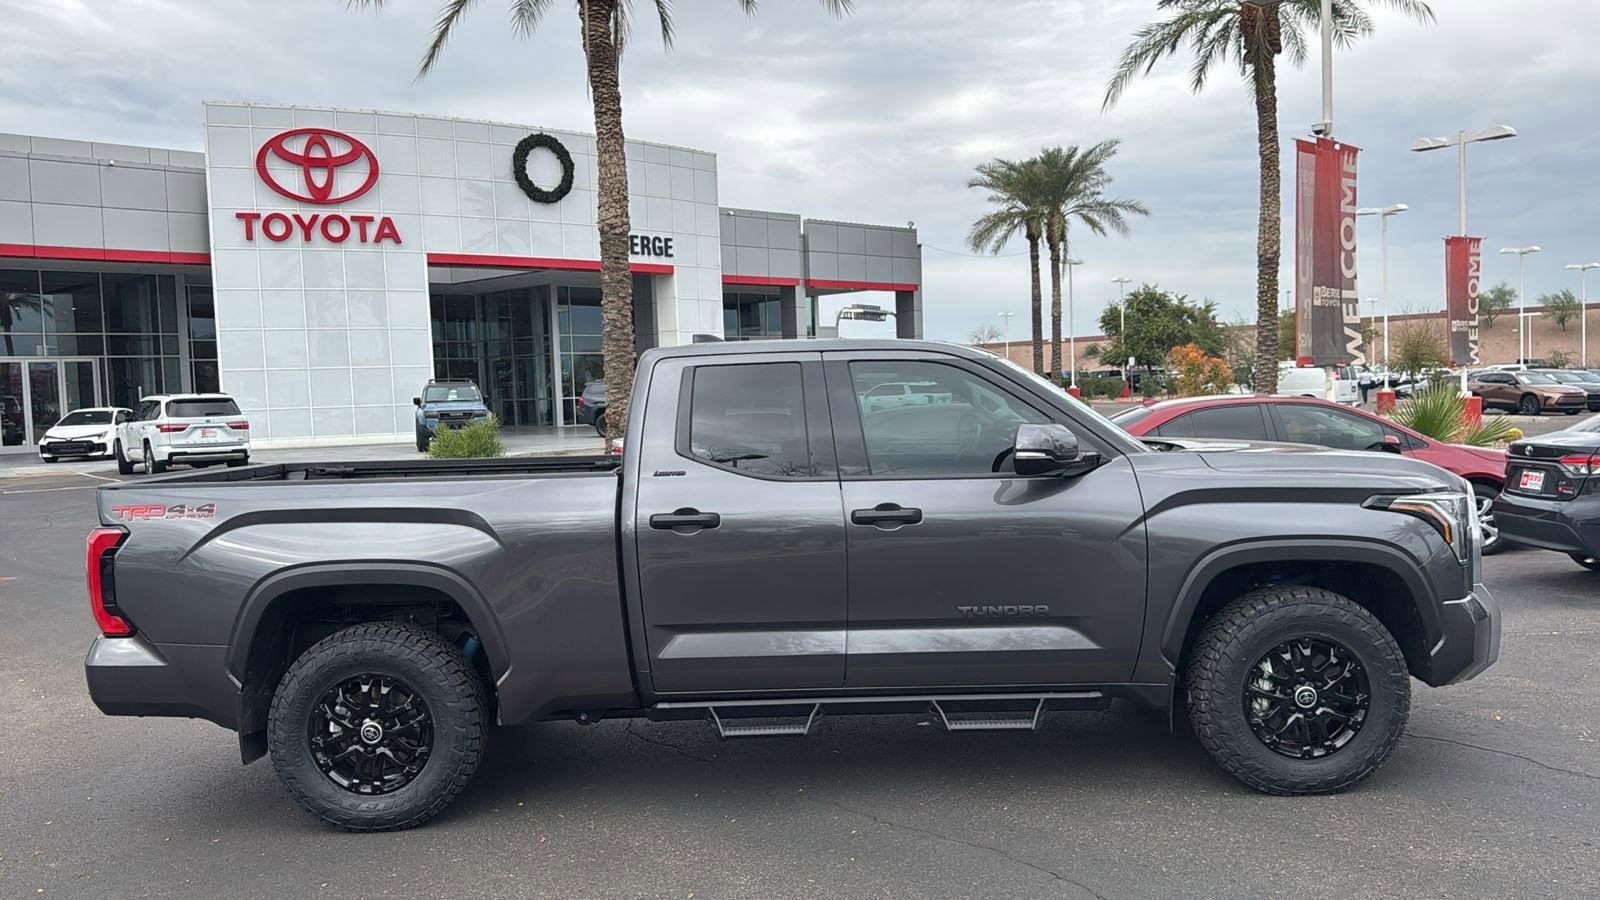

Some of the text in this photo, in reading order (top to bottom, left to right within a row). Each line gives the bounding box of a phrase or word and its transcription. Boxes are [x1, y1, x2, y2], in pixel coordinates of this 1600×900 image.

[235, 212, 402, 244] TOYOTA
[629, 234, 674, 257] ERGE
[1340, 151, 1366, 366] WELCOME
[1468, 240, 1480, 364] WELCOME
[112, 504, 167, 521] TRD
[957, 604, 1051, 617] TUNDRA
